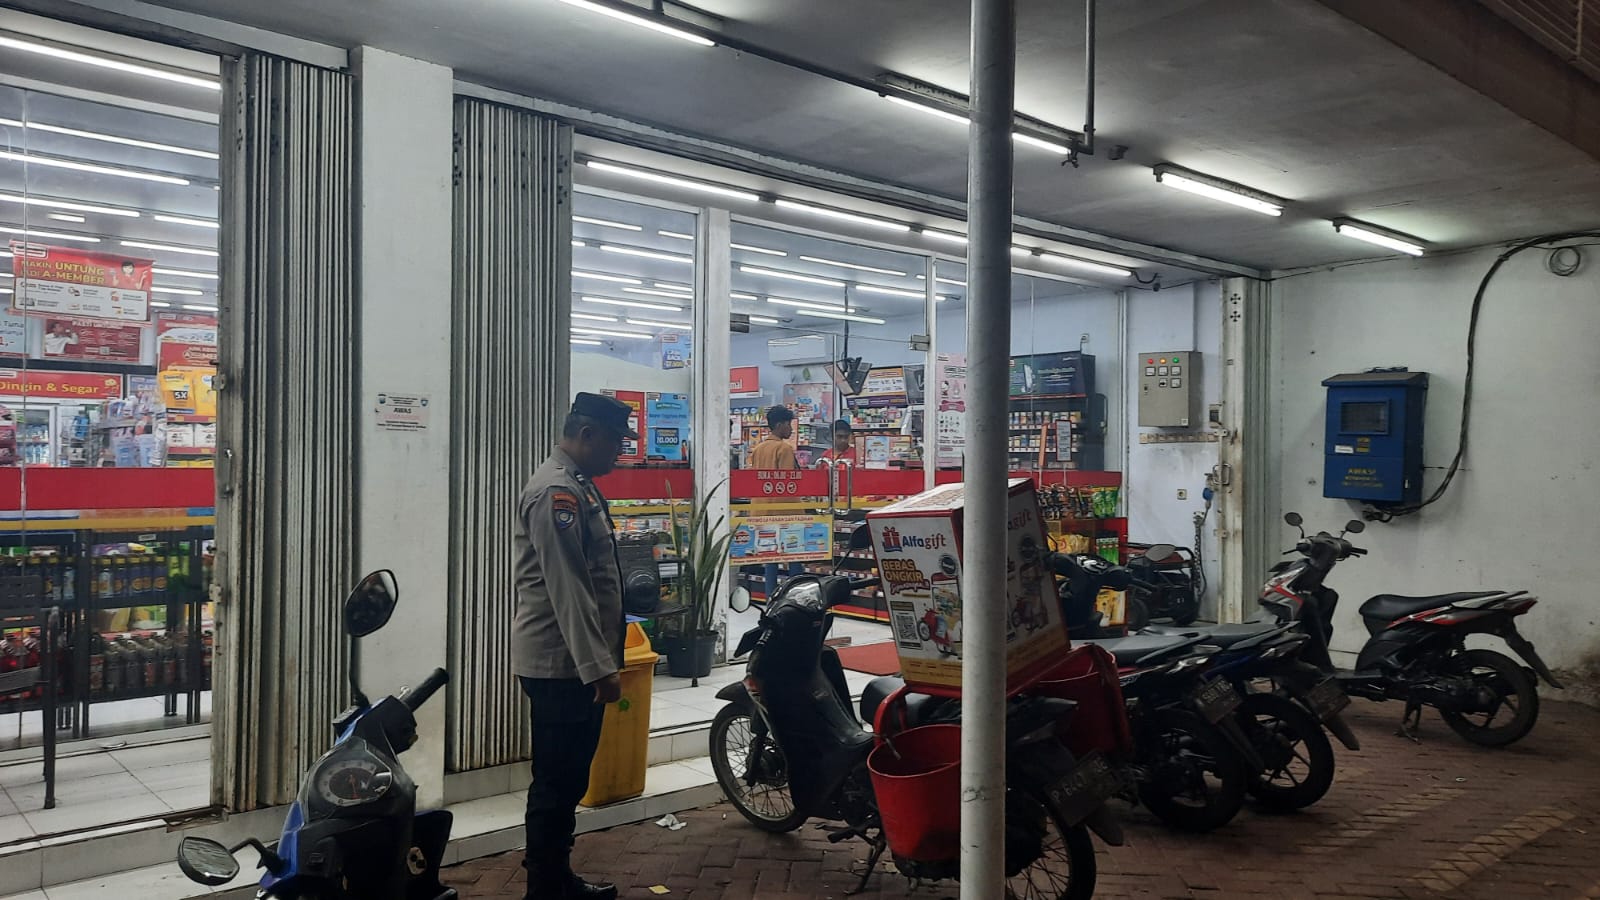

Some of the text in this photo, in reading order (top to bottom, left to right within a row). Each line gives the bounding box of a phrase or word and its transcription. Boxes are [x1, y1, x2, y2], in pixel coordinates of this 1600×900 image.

[55, 262, 104, 275] UNTUNG
[43, 270, 105, 284] A-MEMBER
[0, 381, 99, 395] Dingin & Segar
[902, 533, 947, 550] Alfagift
[882, 560, 915, 571] BEBAS
[884, 571, 923, 583] ONGKIR
